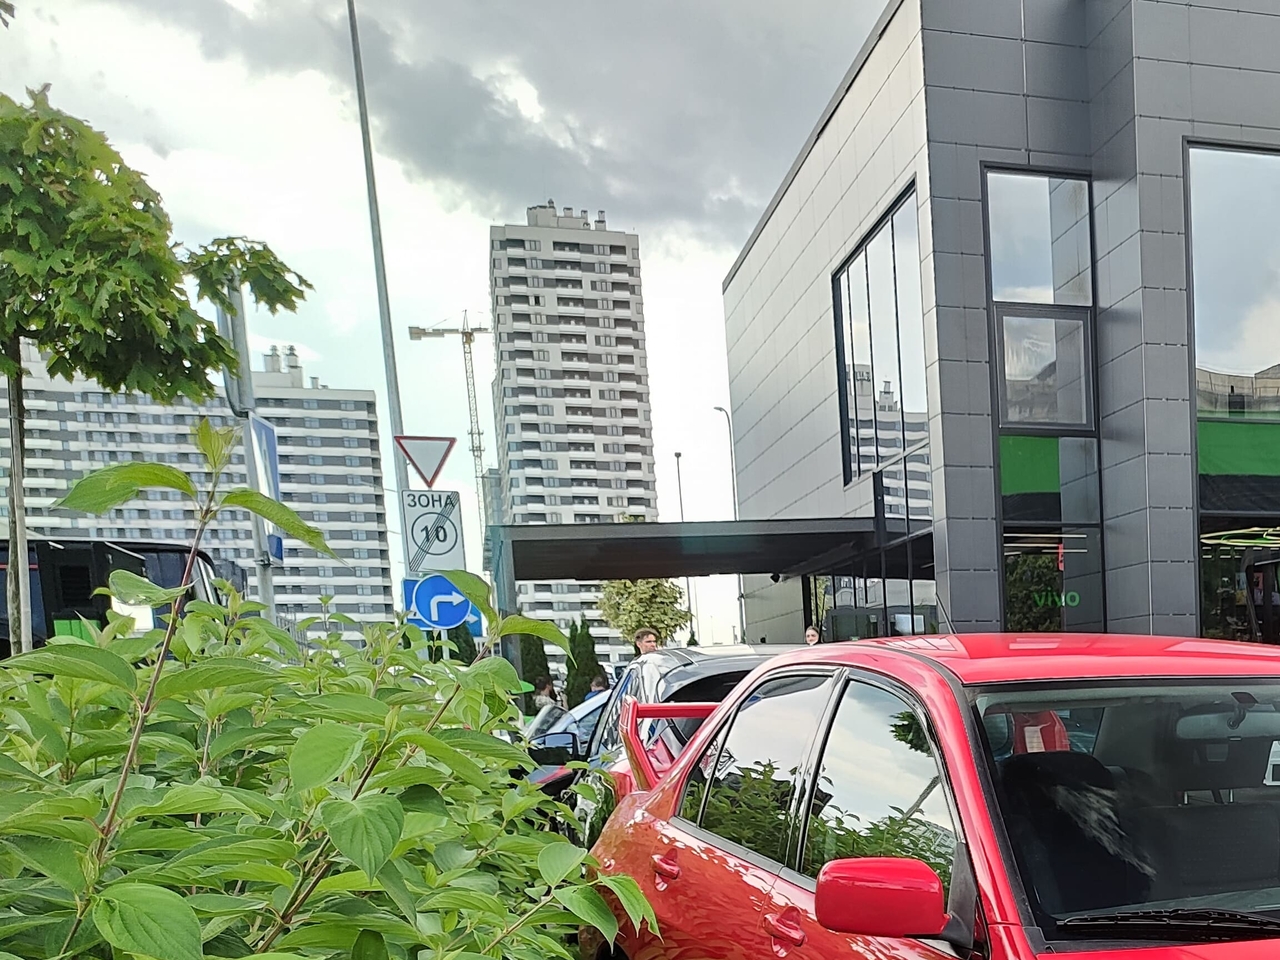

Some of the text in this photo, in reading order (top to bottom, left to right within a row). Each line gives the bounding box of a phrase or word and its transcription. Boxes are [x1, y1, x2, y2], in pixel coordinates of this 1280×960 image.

[406, 493, 456, 508] ЗОНА
[420, 525, 448, 543] 10
[1033, 587, 1080, 607] vivo
